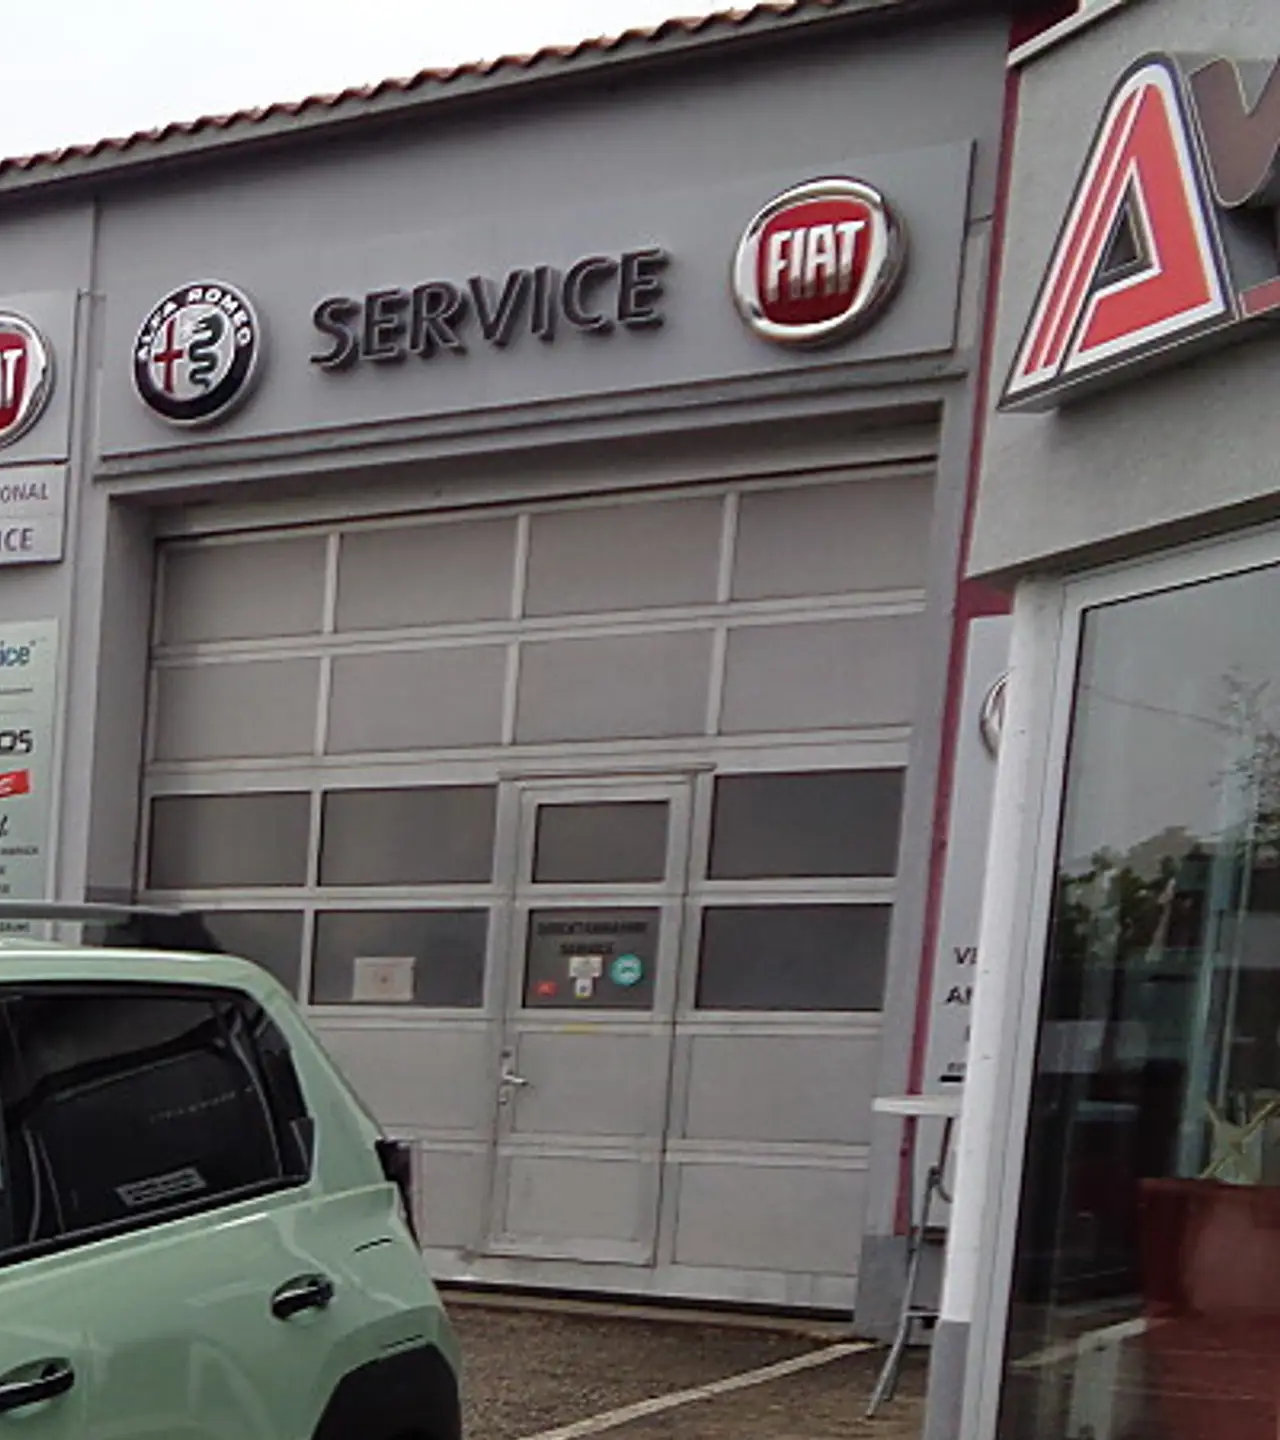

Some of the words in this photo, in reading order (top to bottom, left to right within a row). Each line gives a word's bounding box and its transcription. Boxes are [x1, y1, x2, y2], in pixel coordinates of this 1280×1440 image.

[763, 218, 868, 307] FIAT
[138, 301, 178, 361] ALFA
[187, 287, 252, 347] ROMEO
[311, 247, 671, 370] SERVICE
